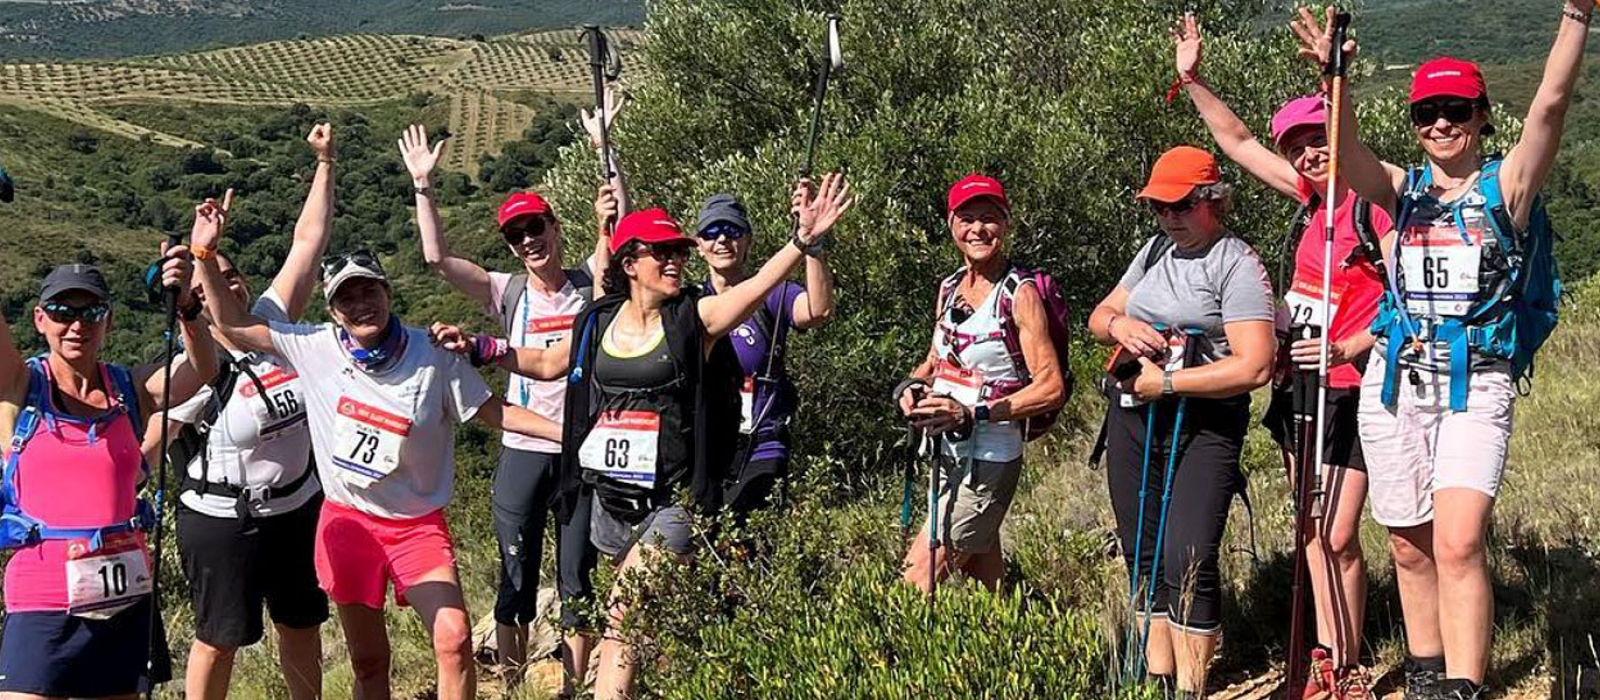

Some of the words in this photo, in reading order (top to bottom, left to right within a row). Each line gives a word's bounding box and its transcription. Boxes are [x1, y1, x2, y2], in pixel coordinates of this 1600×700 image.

[1423, 256, 1449, 289] 65
[273, 389, 299, 419] 56
[349, 431, 380, 464] 73
[605, 438, 630, 469] 63
[98, 562, 128, 598] 10
